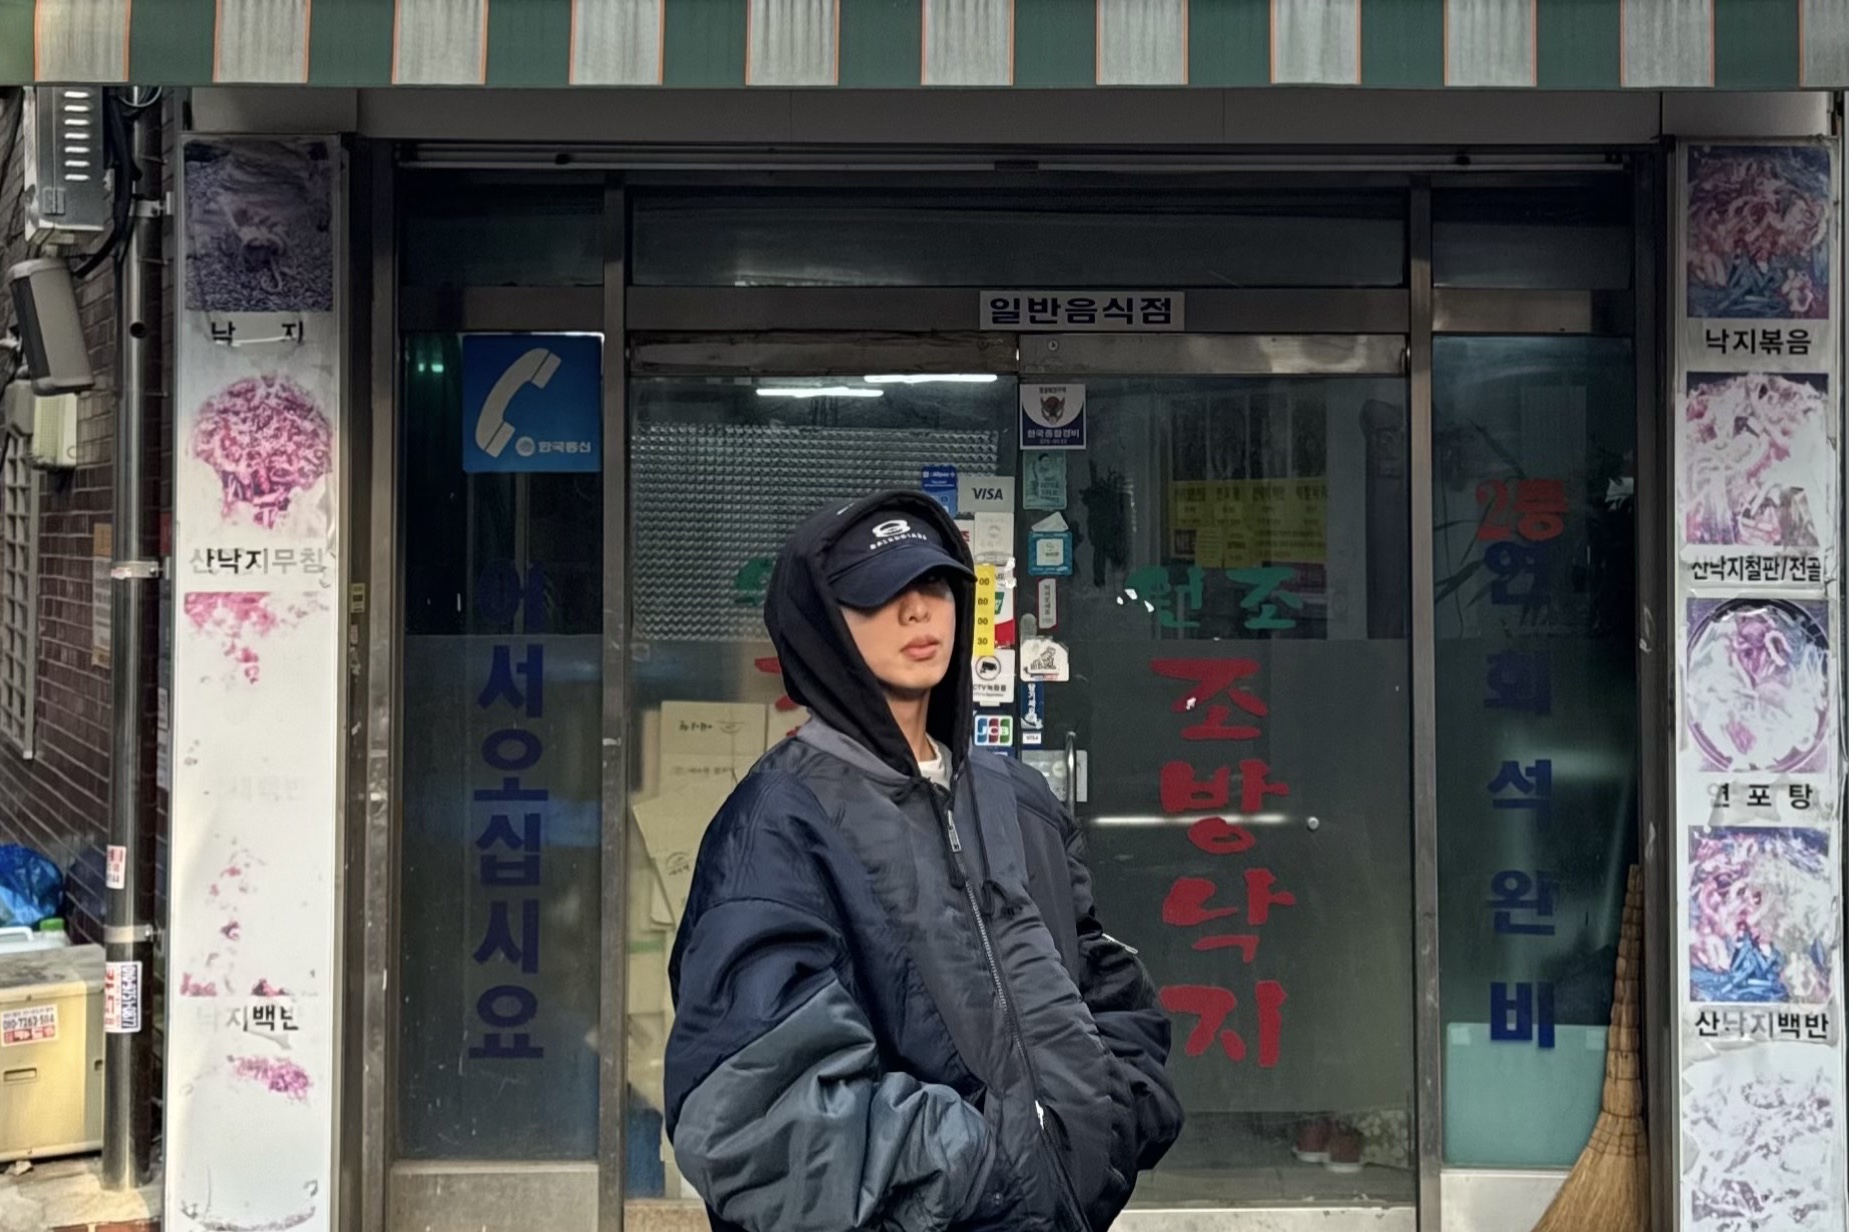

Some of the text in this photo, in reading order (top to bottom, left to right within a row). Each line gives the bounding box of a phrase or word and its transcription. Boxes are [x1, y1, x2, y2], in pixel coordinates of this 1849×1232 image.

[990, 297, 1172, 325] 일반음식점
[1705, 328, 1812, 355] 낙지볶음
[538, 441, 591, 453] 한국통신
[971, 487, 1004, 501] VISA
[190, 547, 324, 575] 산낙지무침
[1691, 555, 1822, 582] 산낙지철판/전골
[1150, 658, 1296, 1069] 조방낙지
[1695, 1010, 1829, 1039] 산낙지백반
